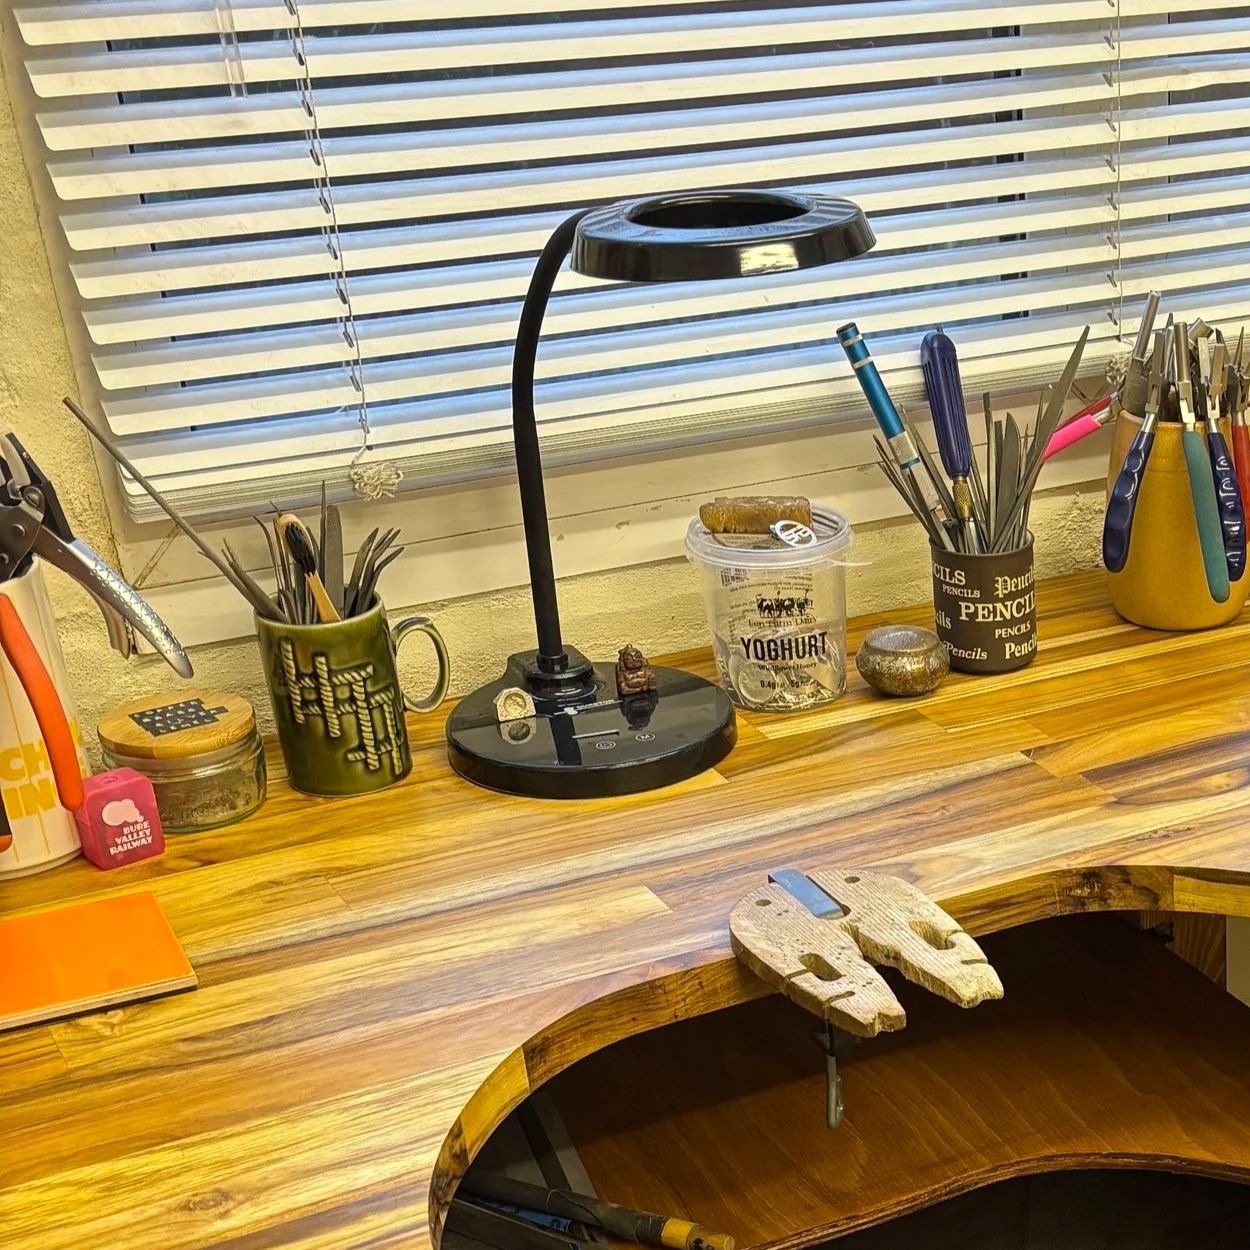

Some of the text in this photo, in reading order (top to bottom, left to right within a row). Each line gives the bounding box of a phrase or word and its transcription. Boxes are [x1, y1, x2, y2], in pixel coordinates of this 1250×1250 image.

[933, 562, 966, 586] CILS
[942, 584, 981, 598] PENCILS
[958, 590, 1036, 622] PENCIL
[995, 620, 1031, 638] PENCILS
[740, 631, 828, 661] YOGHURT
[942, 640, 988, 660] Pencils
[114, 828, 151, 844] VALLEY
[122, 820, 150, 835] BURE
[109, 835, 152, 855] RAILWAY
